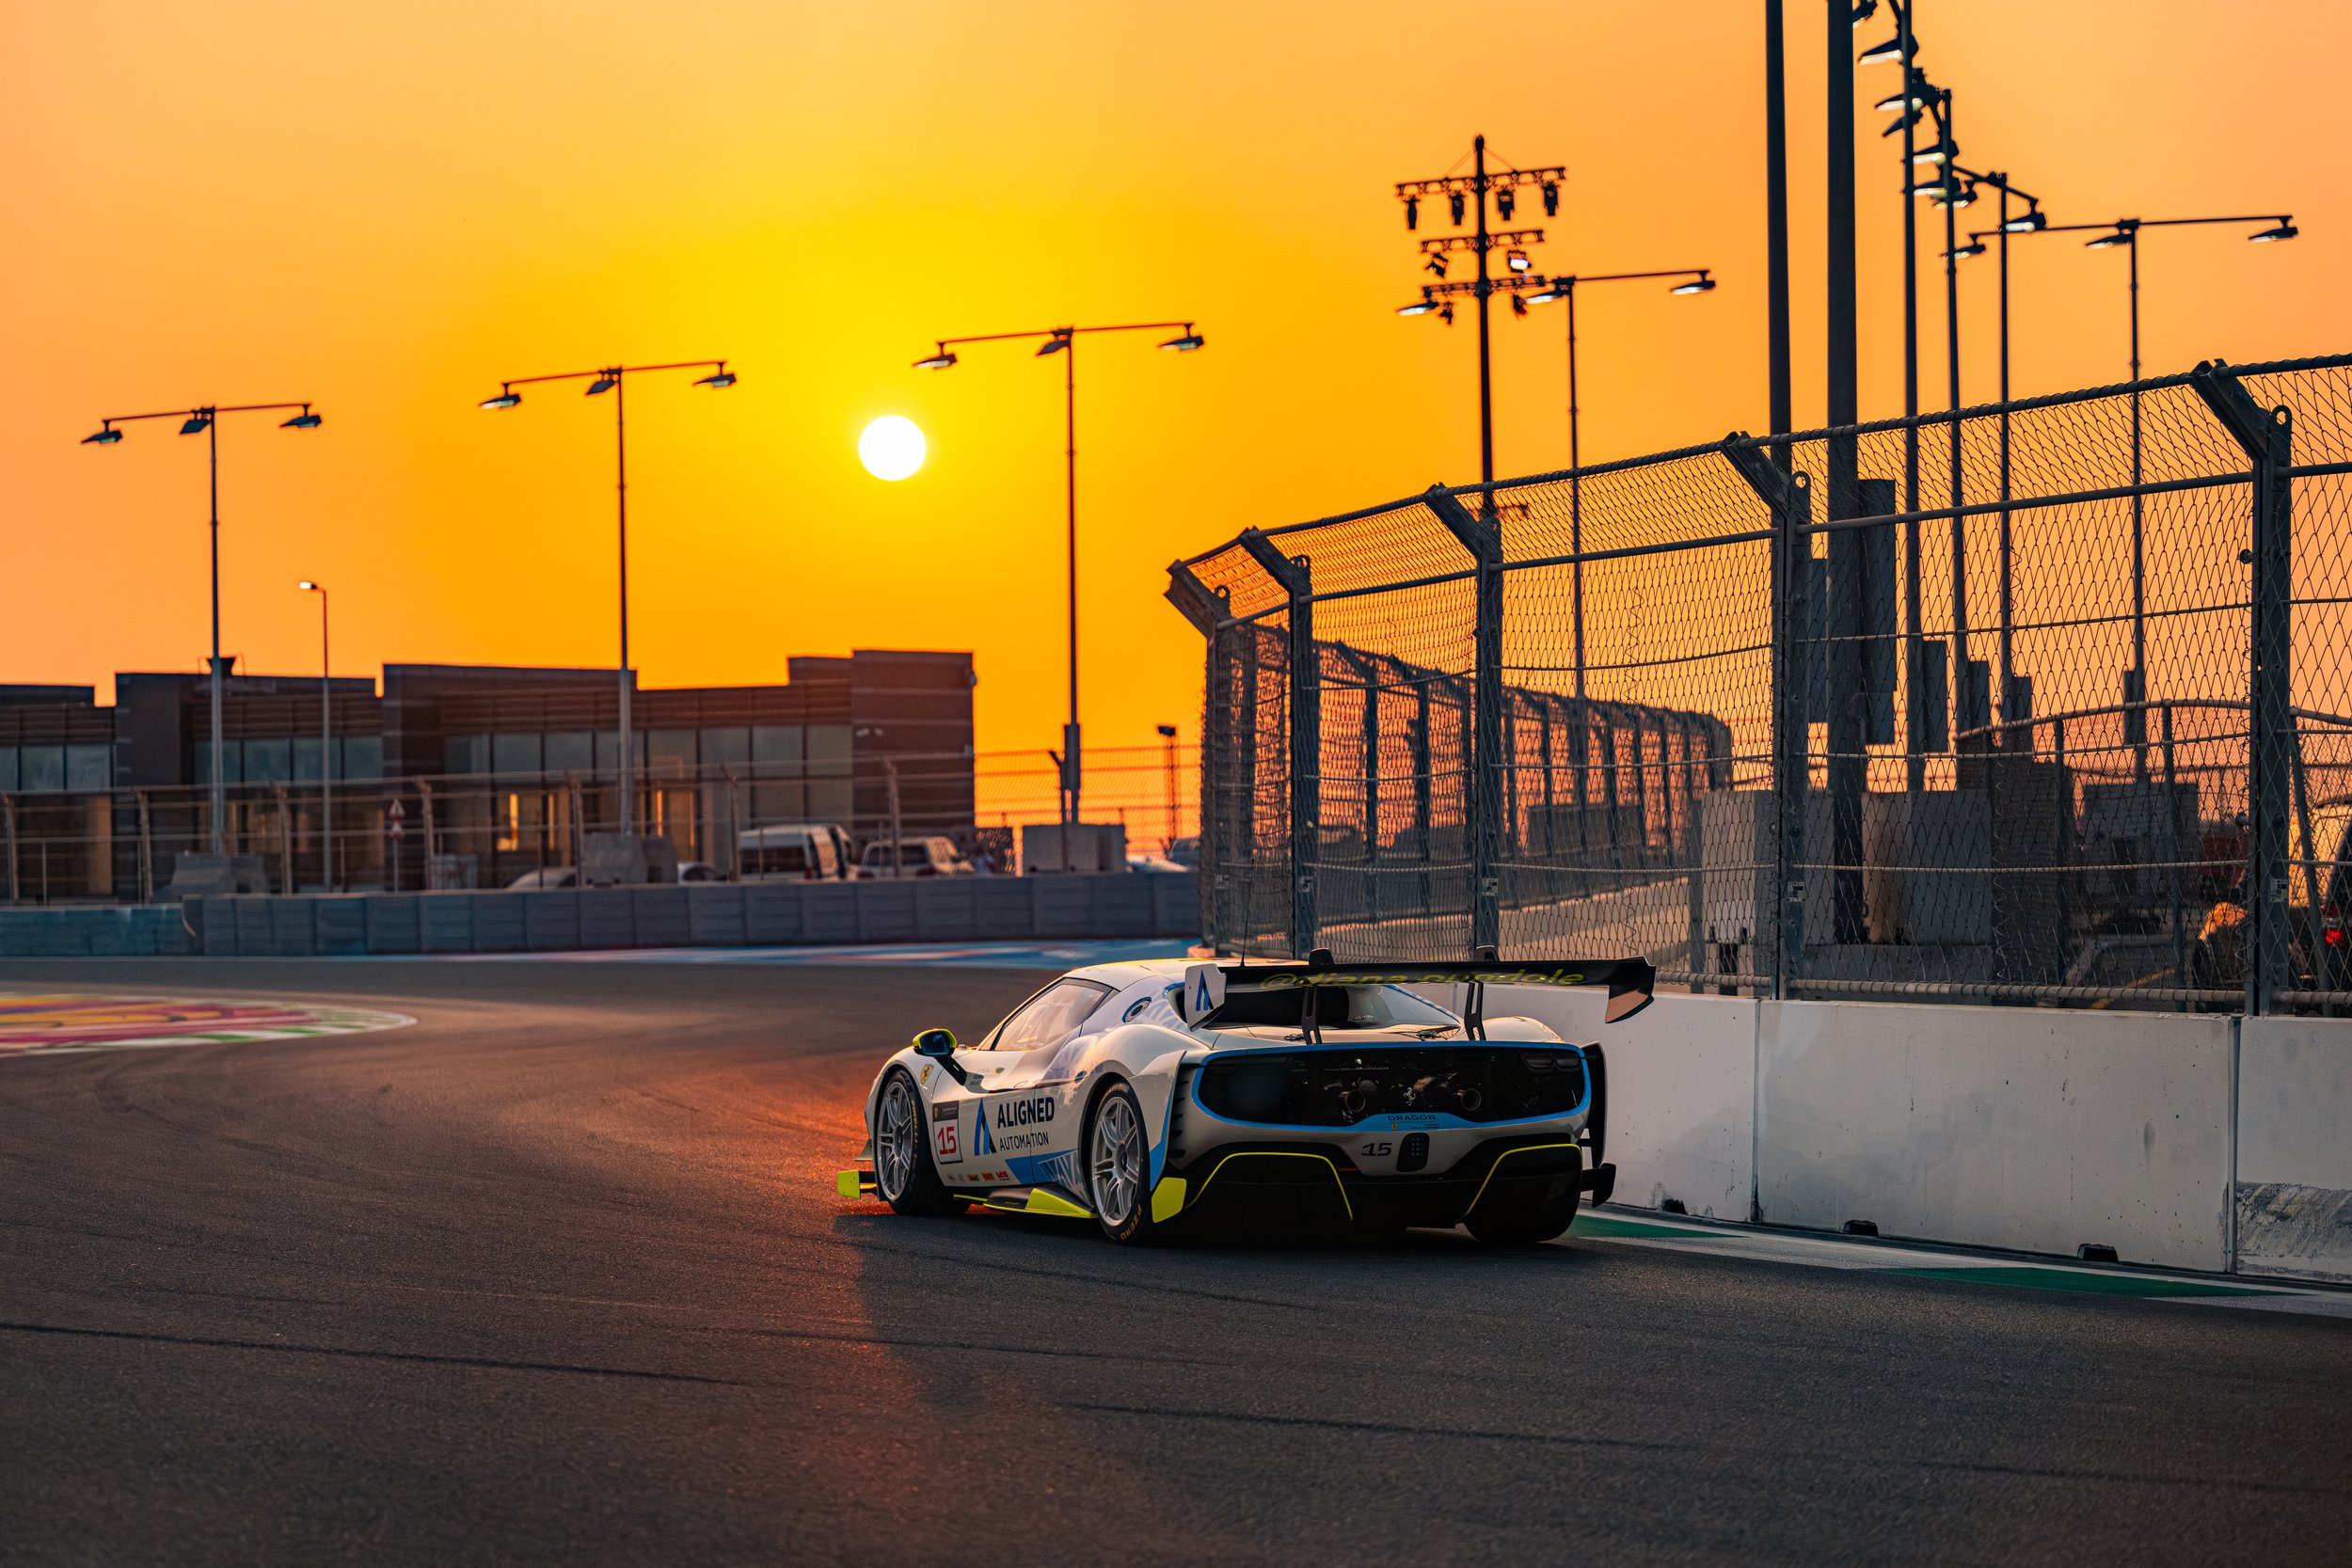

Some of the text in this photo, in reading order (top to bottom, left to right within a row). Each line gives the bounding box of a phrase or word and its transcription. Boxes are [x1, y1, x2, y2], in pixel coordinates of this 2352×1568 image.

[997, 1097, 1055, 1129] ALIGNED
[937, 1126, 957, 1155] 15
[999, 1132, 1050, 1151] AUTOMATION
[1360, 1142, 1392, 1156] 15
